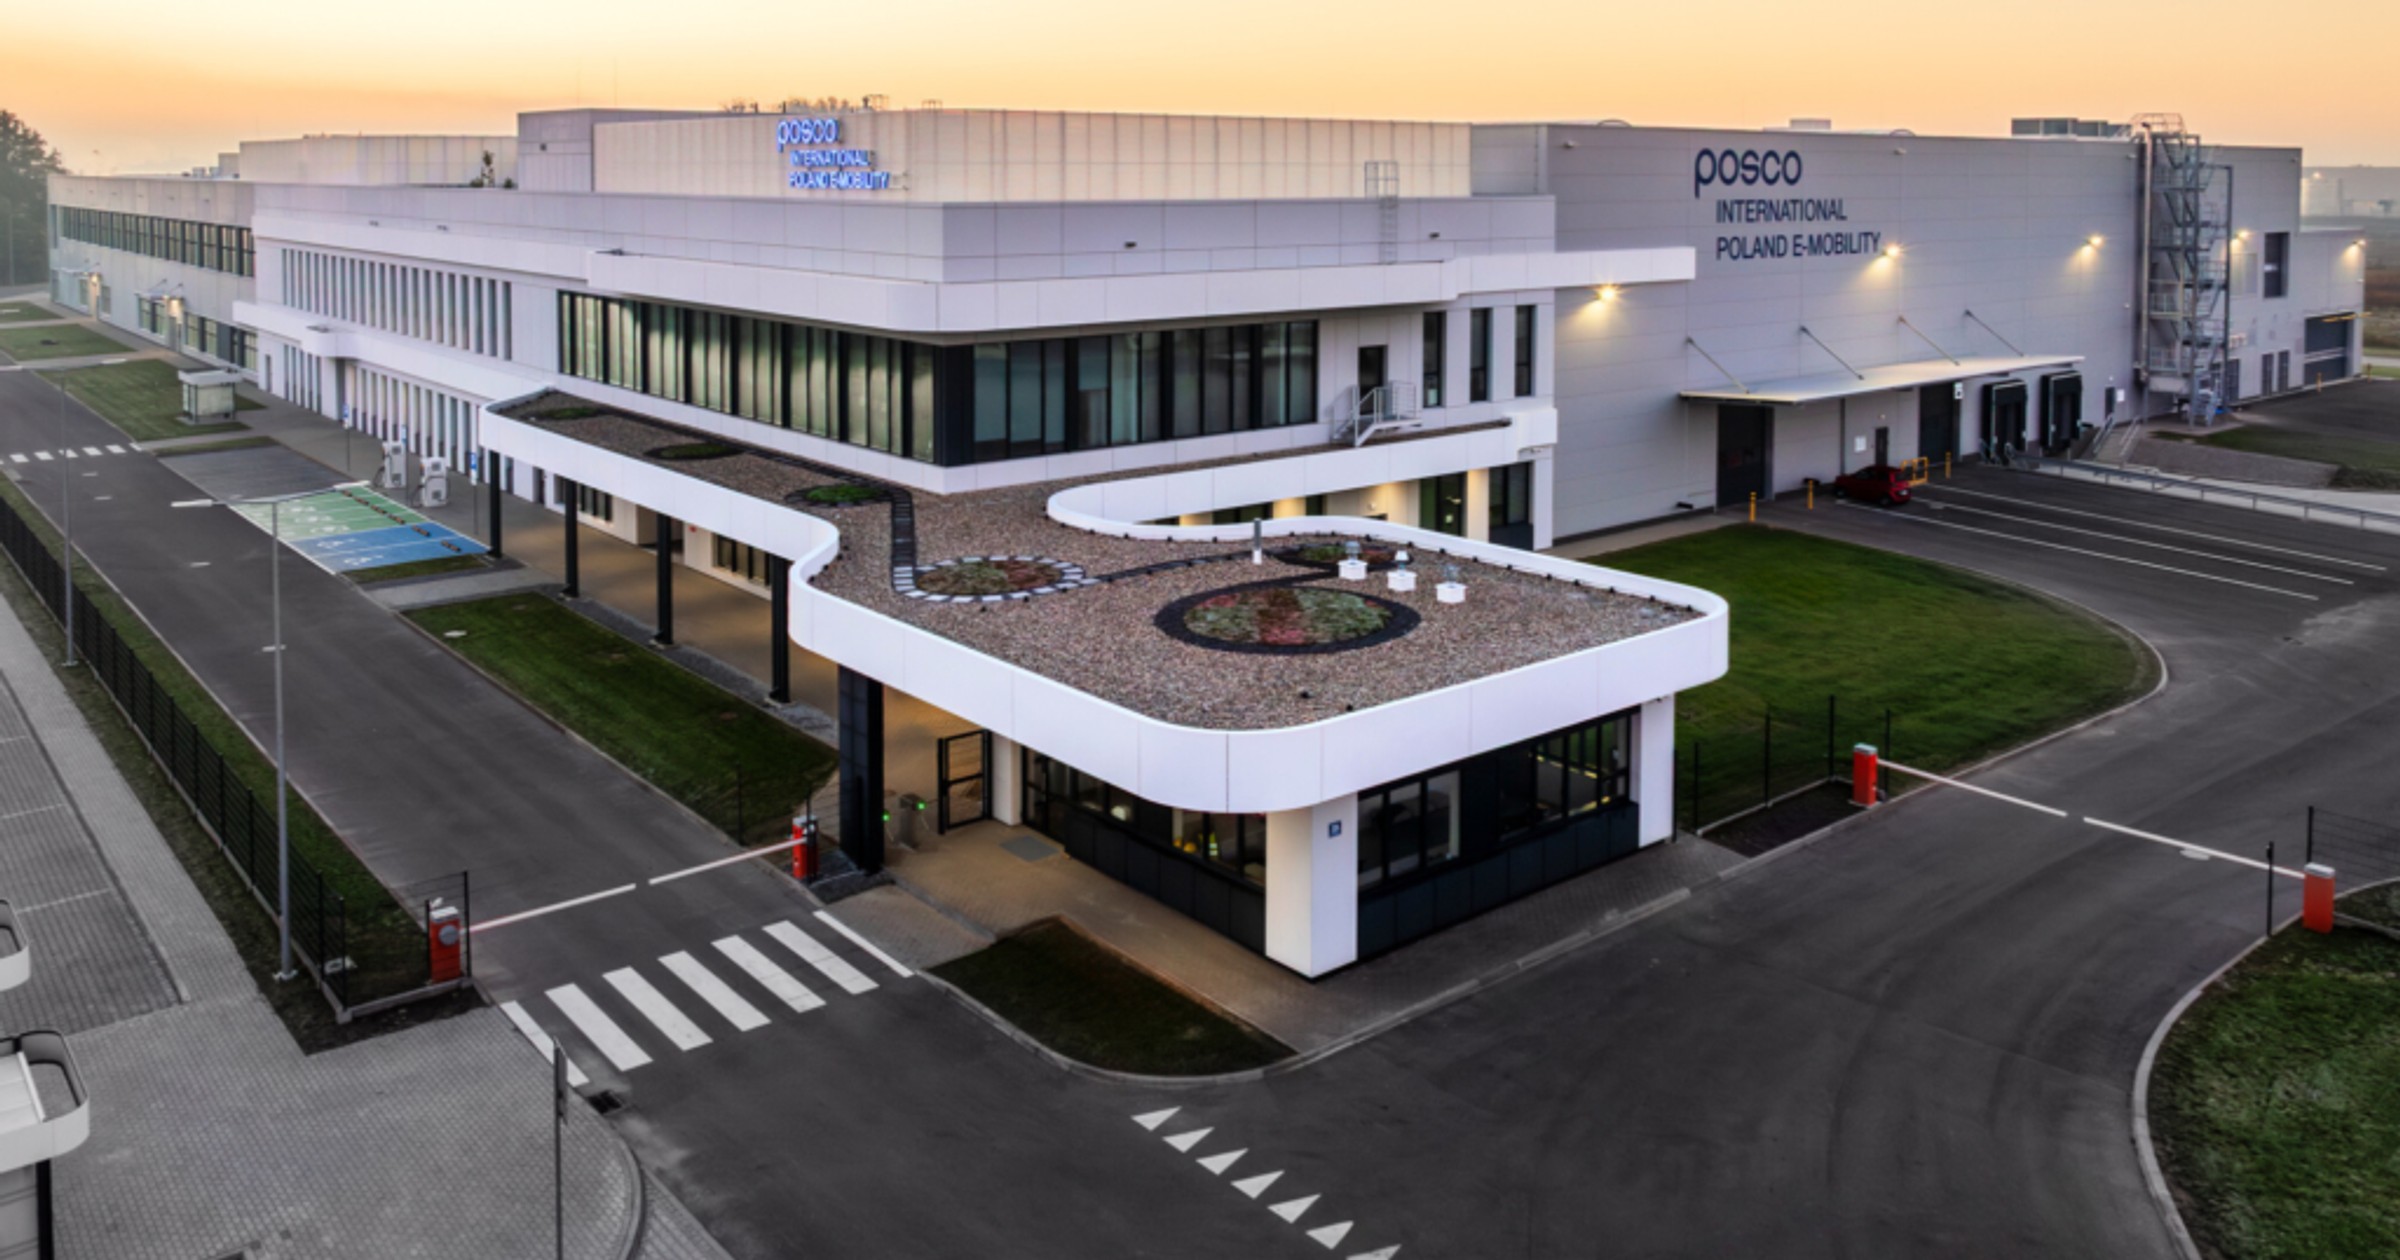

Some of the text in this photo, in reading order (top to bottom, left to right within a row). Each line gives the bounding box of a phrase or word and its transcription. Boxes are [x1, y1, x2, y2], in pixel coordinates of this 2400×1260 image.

[777, 118, 839, 152] posco
[790, 150, 870, 167] INTERNATIONAL
[789, 172, 829, 188] POLAND
[1694, 148, 1802, 198] posco
[1716, 199, 1847, 223] INTERNATIONAL
[1716, 232, 1881, 260] POLAND E-MOBILITY
